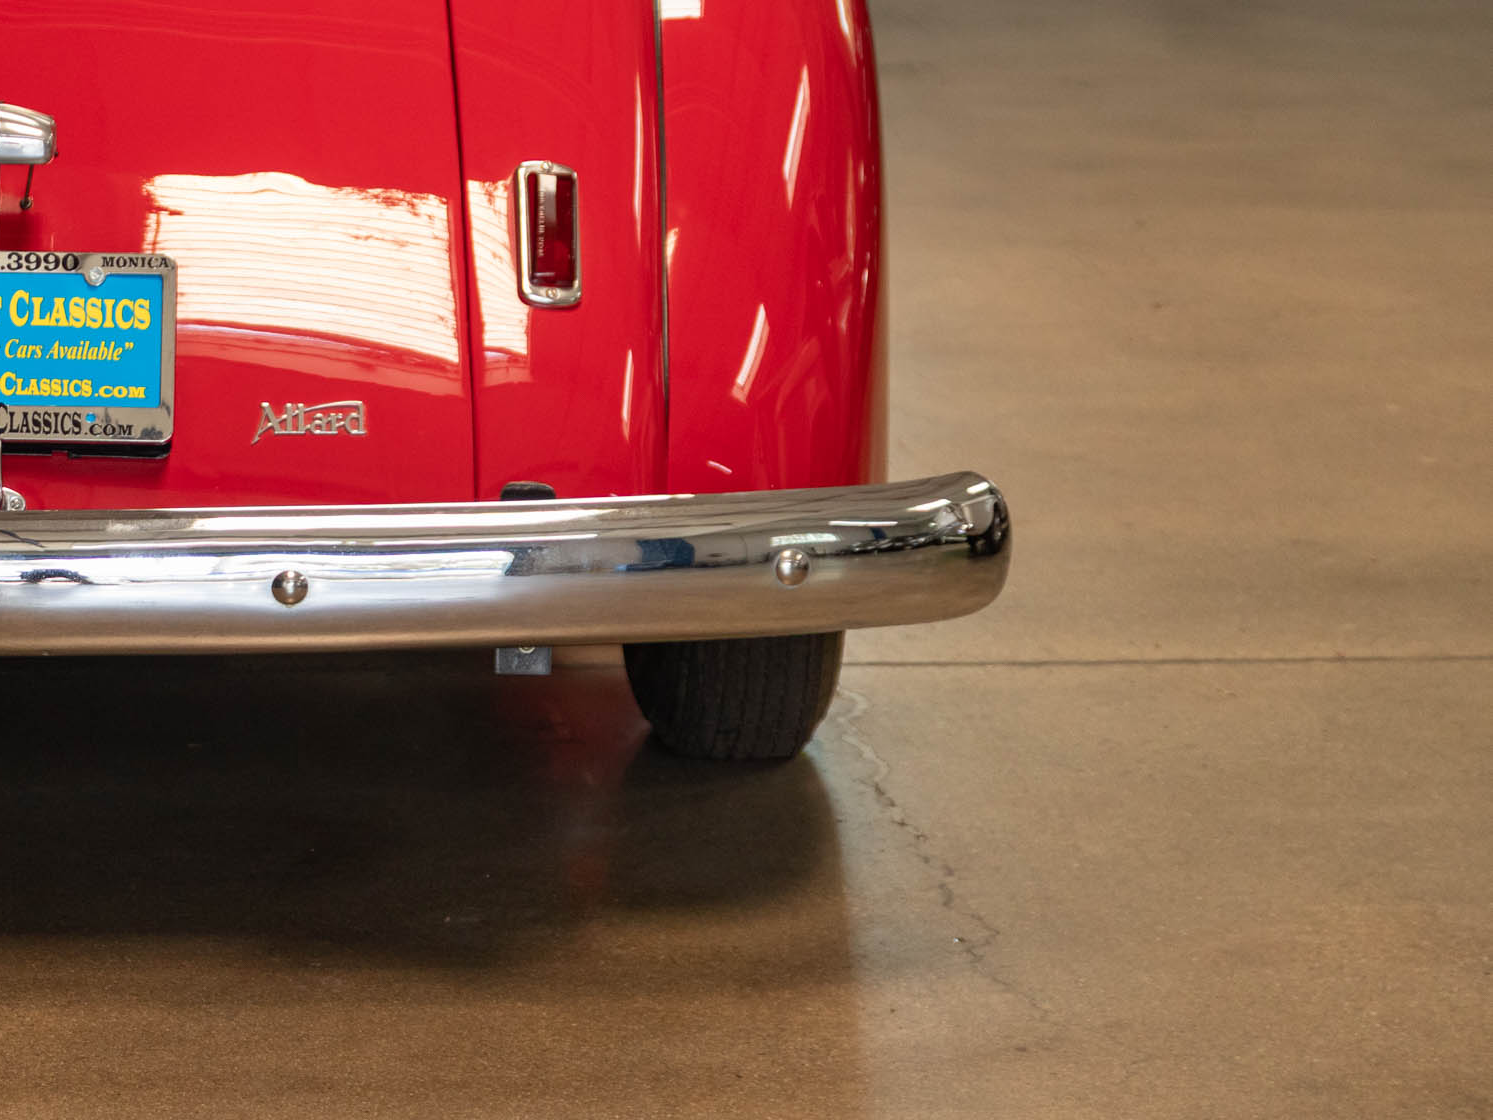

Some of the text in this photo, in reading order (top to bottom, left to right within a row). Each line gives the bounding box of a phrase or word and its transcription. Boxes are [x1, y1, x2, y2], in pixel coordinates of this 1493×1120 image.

[101, 256, 169, 269] MONICA
[4, 338, 43, 359] Cars
[251, 400, 367, 446] Allard
